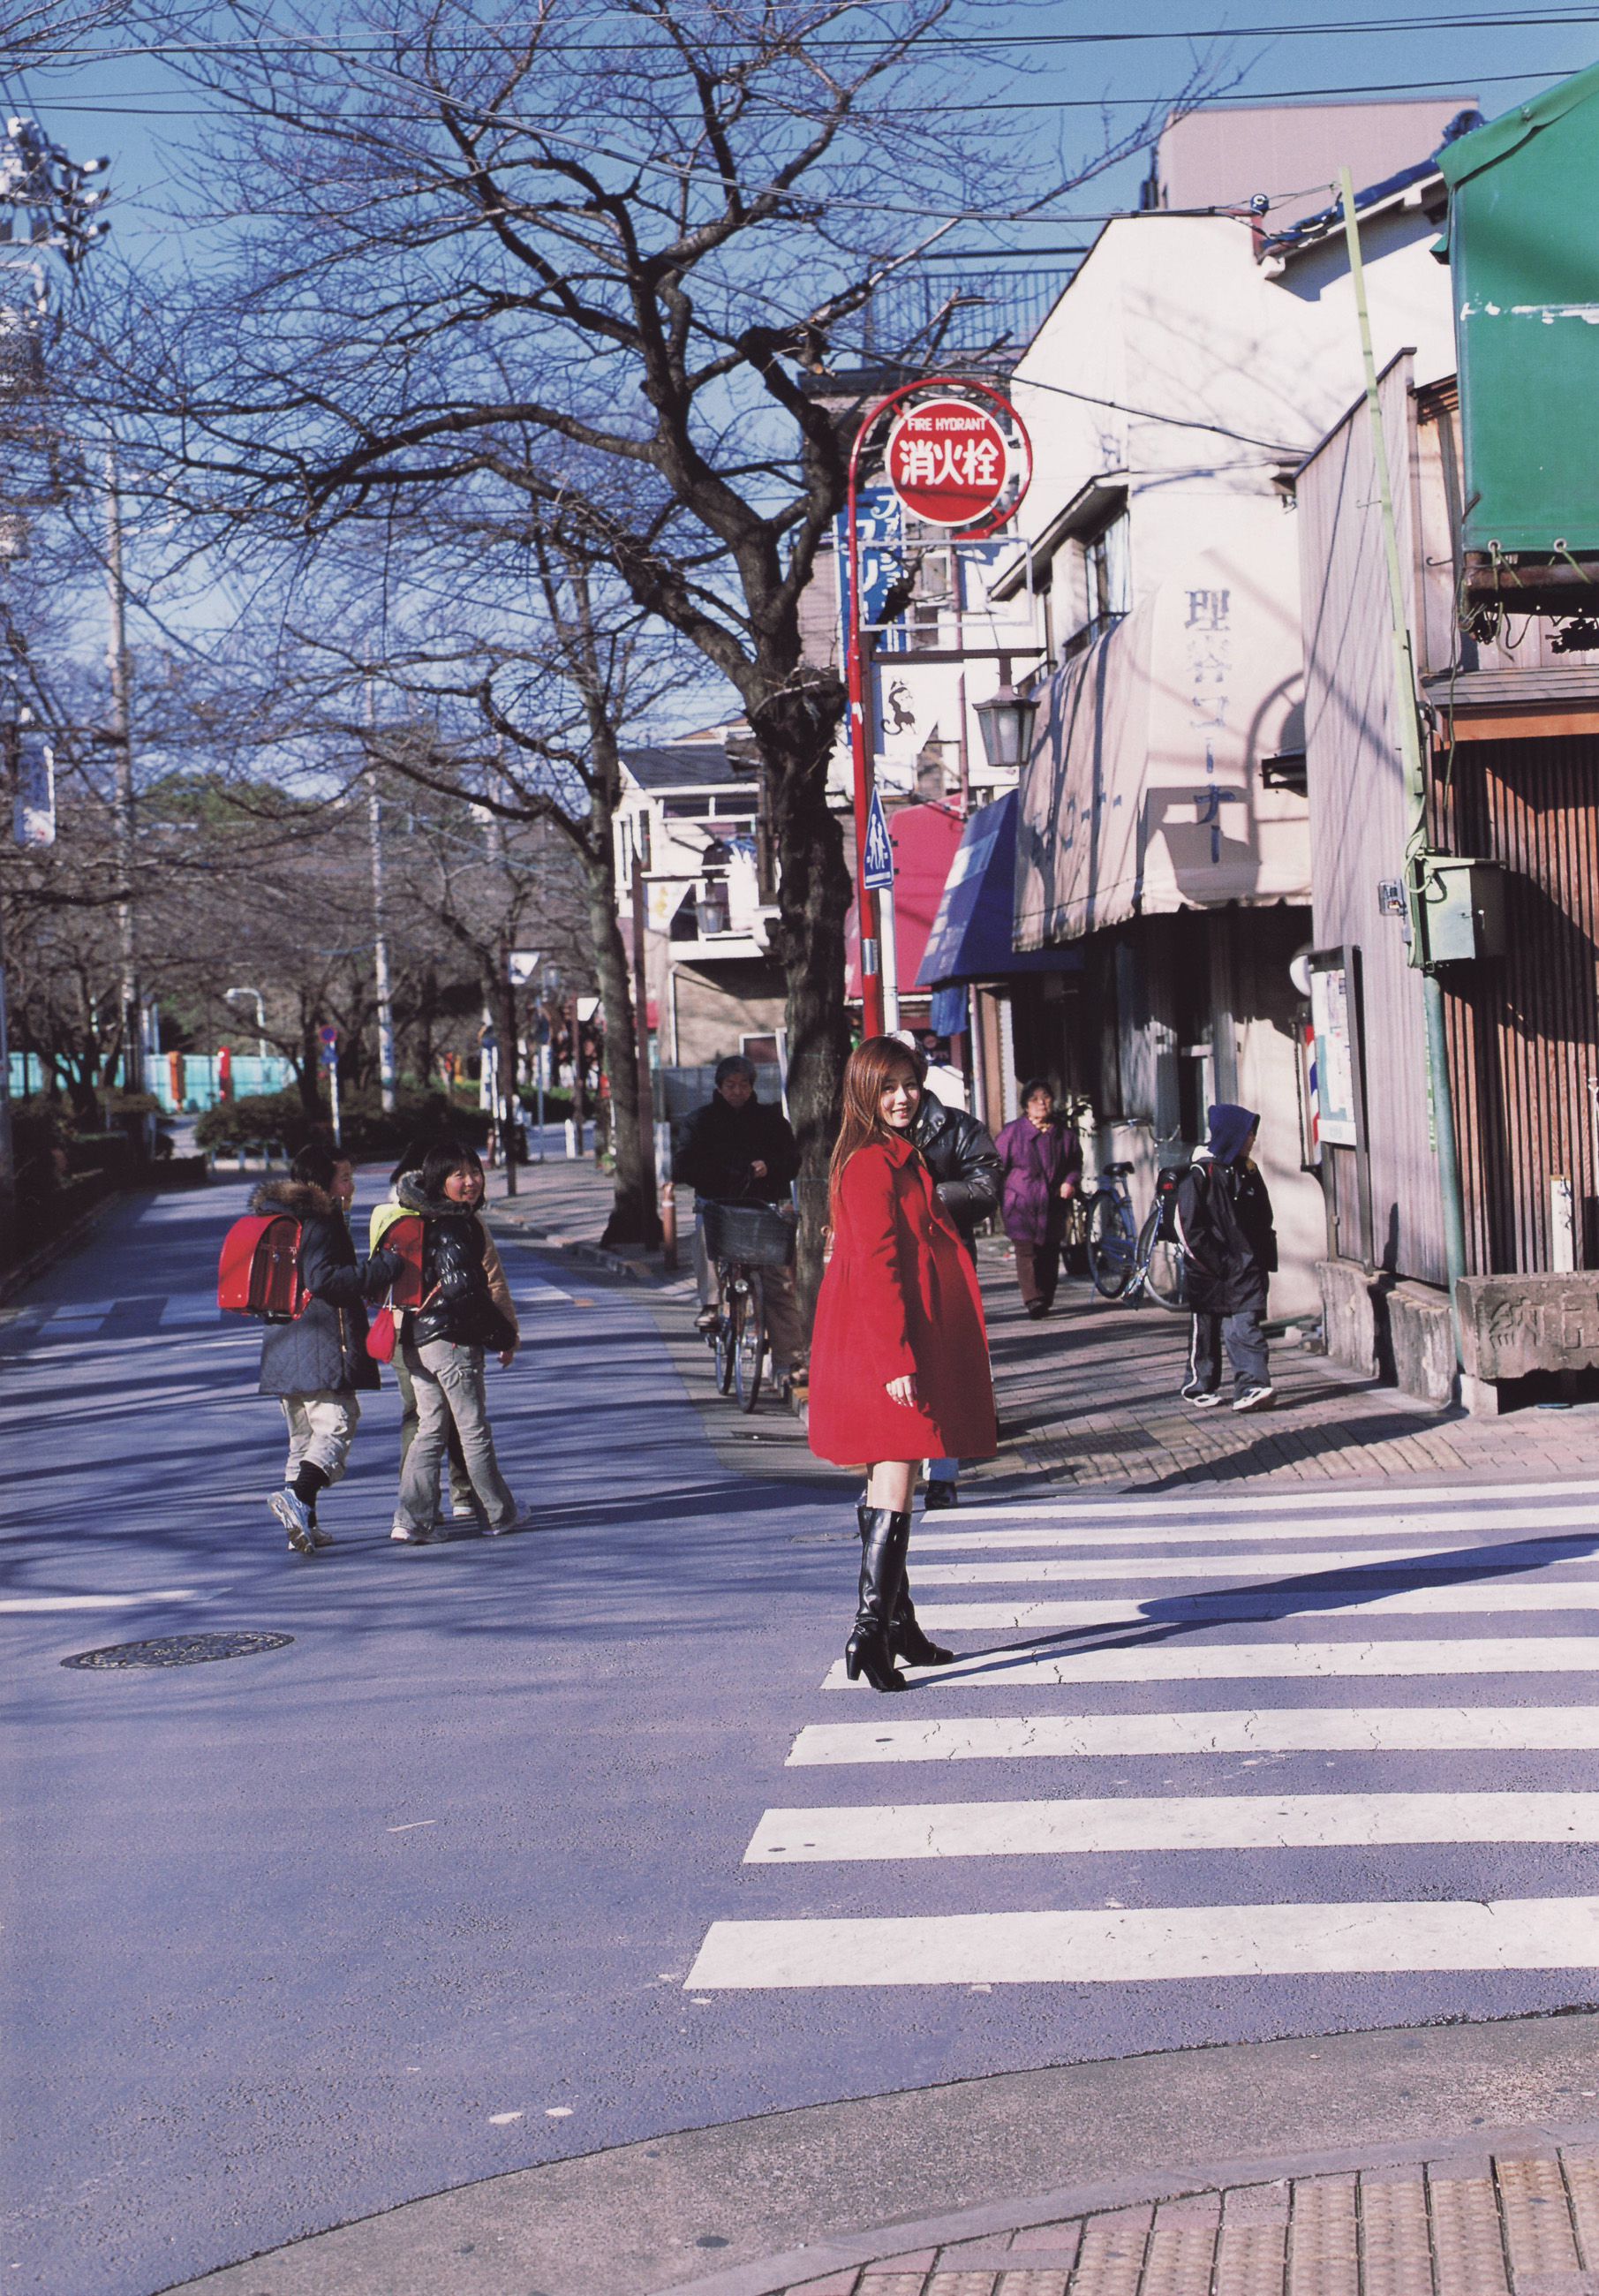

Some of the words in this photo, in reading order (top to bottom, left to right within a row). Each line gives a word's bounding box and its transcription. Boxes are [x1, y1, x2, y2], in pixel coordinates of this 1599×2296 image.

[908, 418, 932, 431] FIRE
[936, 417, 986, 431] HYDRANT
[899, 438, 999, 486] 消火栓
